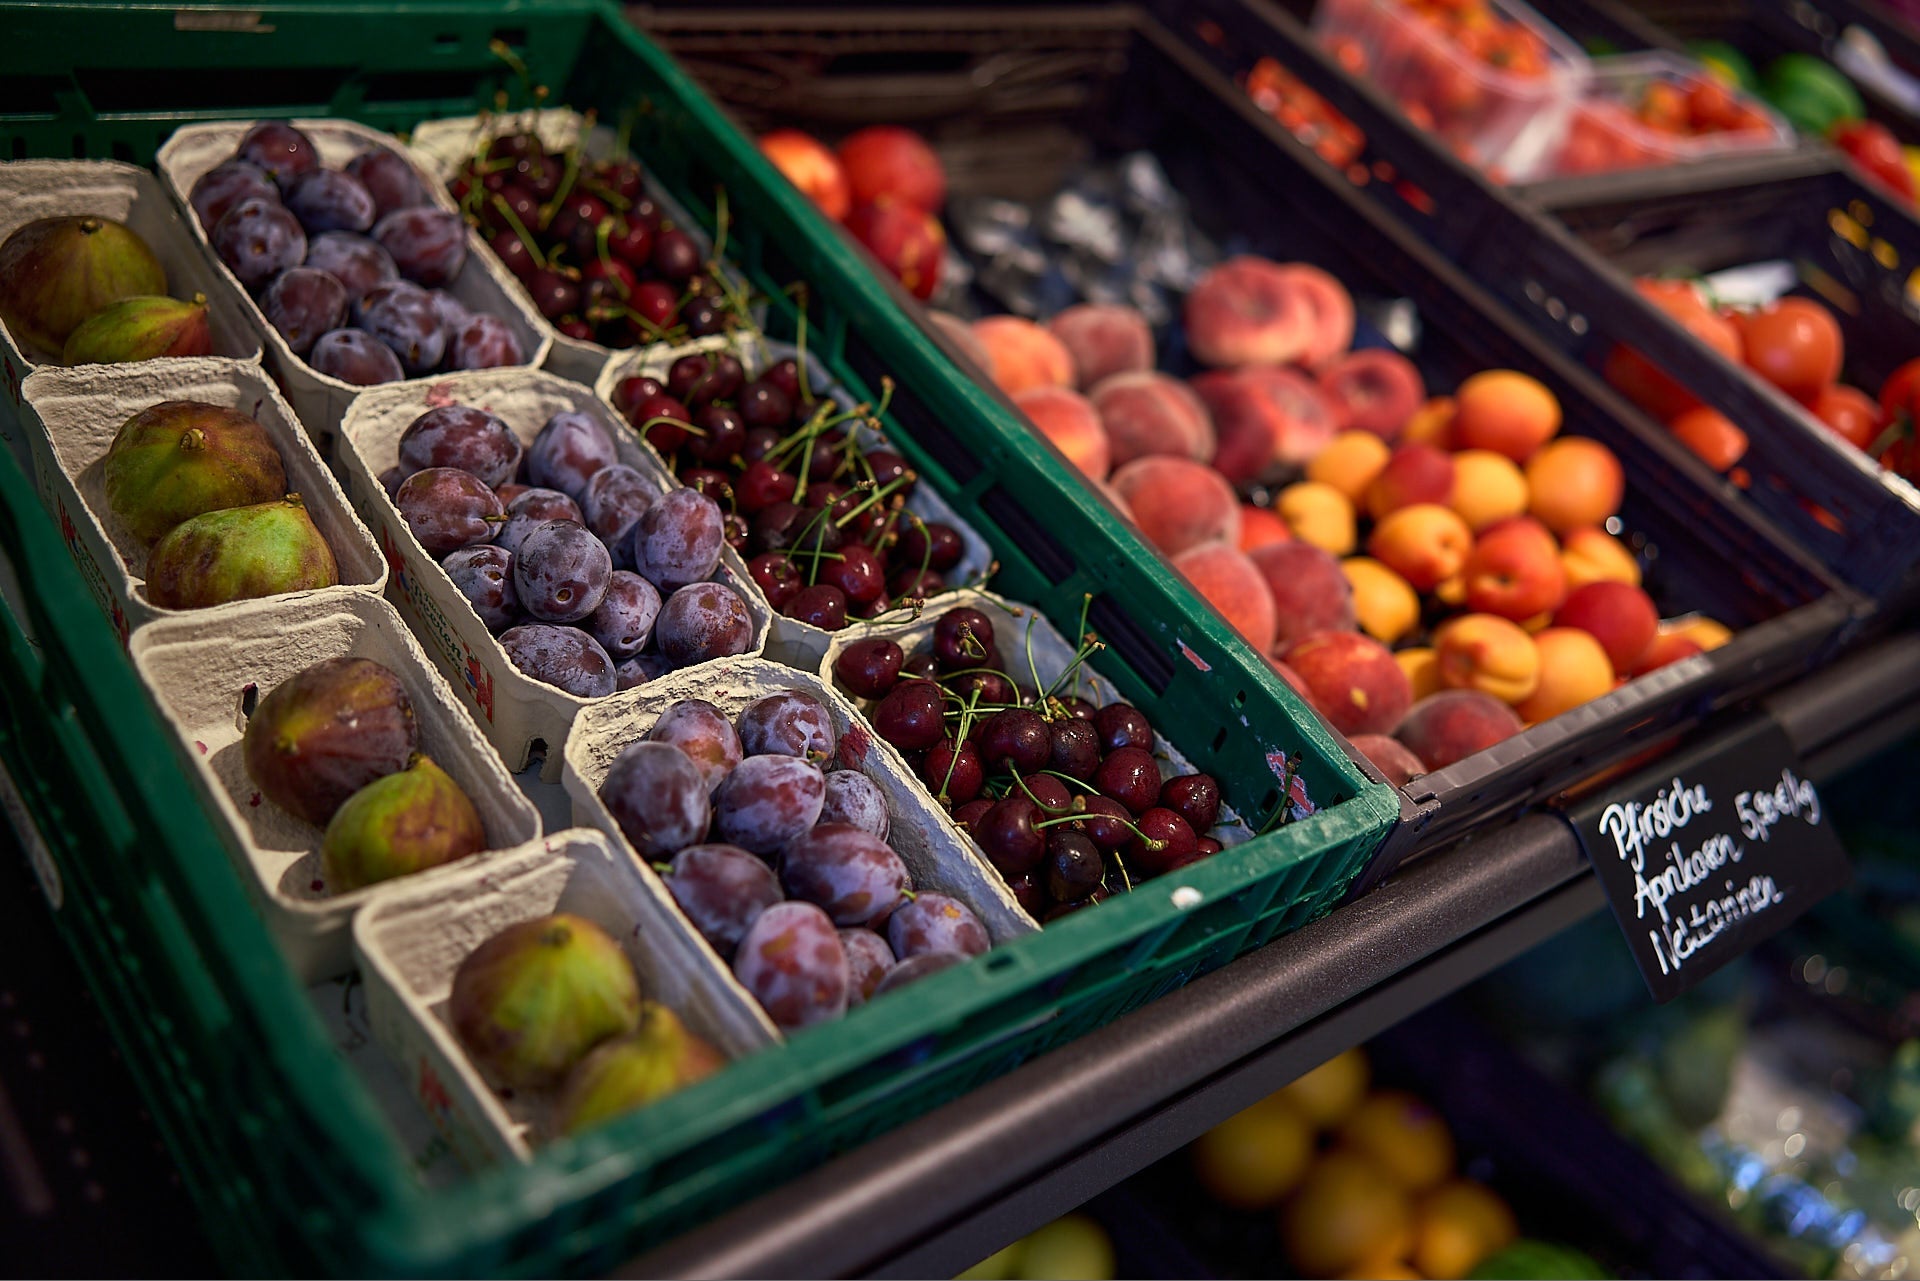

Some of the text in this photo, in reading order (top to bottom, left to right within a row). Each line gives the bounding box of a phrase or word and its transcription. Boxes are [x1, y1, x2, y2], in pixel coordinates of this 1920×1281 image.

[1599, 777, 1712, 872] Pfirsiche
[1633, 833, 1743, 923] Aprikosen
[1649, 875, 1784, 976] Nektarinen
